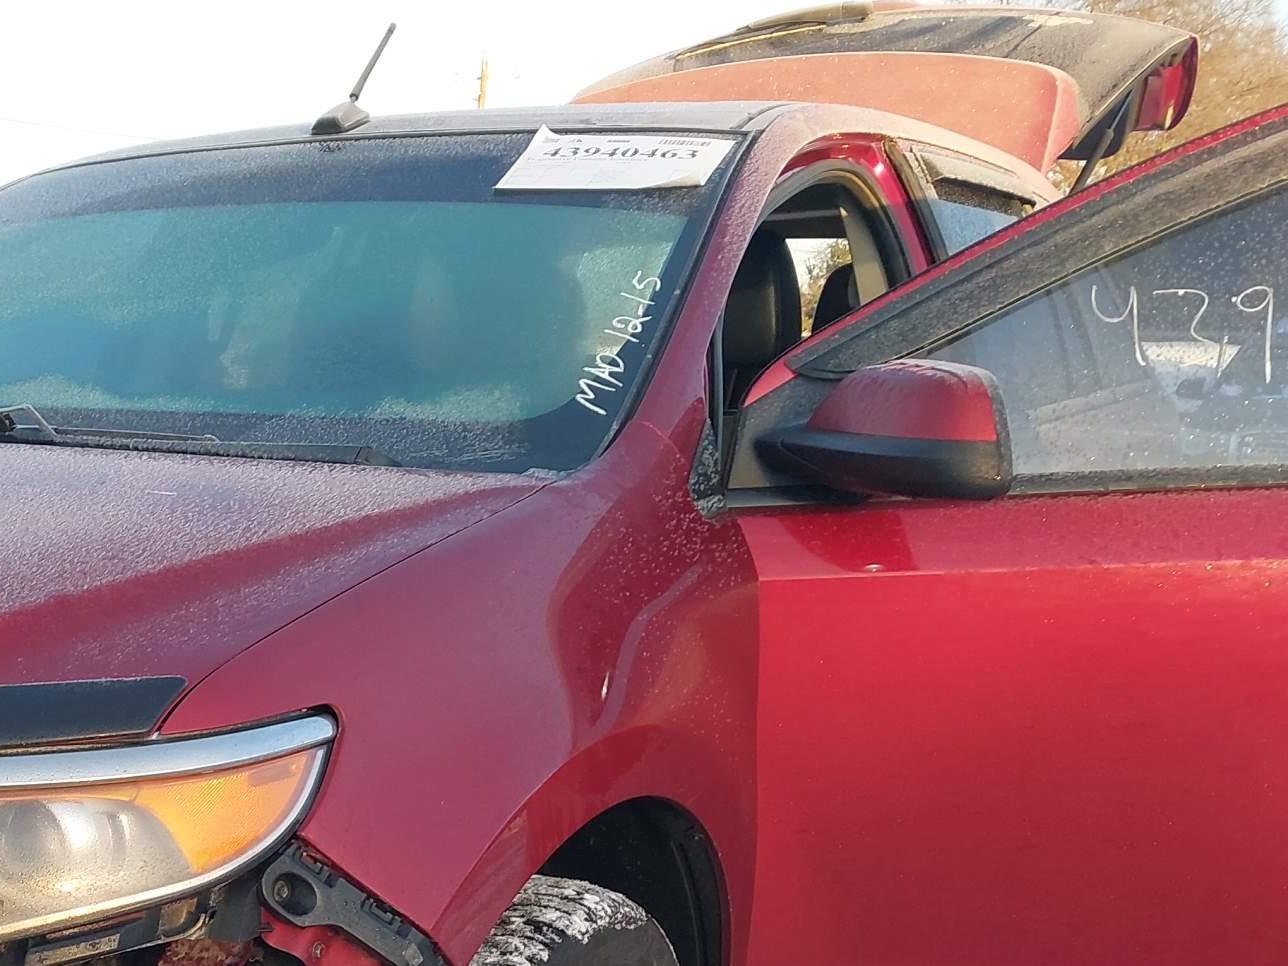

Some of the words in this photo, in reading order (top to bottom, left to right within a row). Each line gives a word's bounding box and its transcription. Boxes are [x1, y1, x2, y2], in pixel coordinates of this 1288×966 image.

[543, 145, 700, 160] 43940463
[603, 269, 662, 343] 12-15
[1090, 285, 1274, 385] 439
